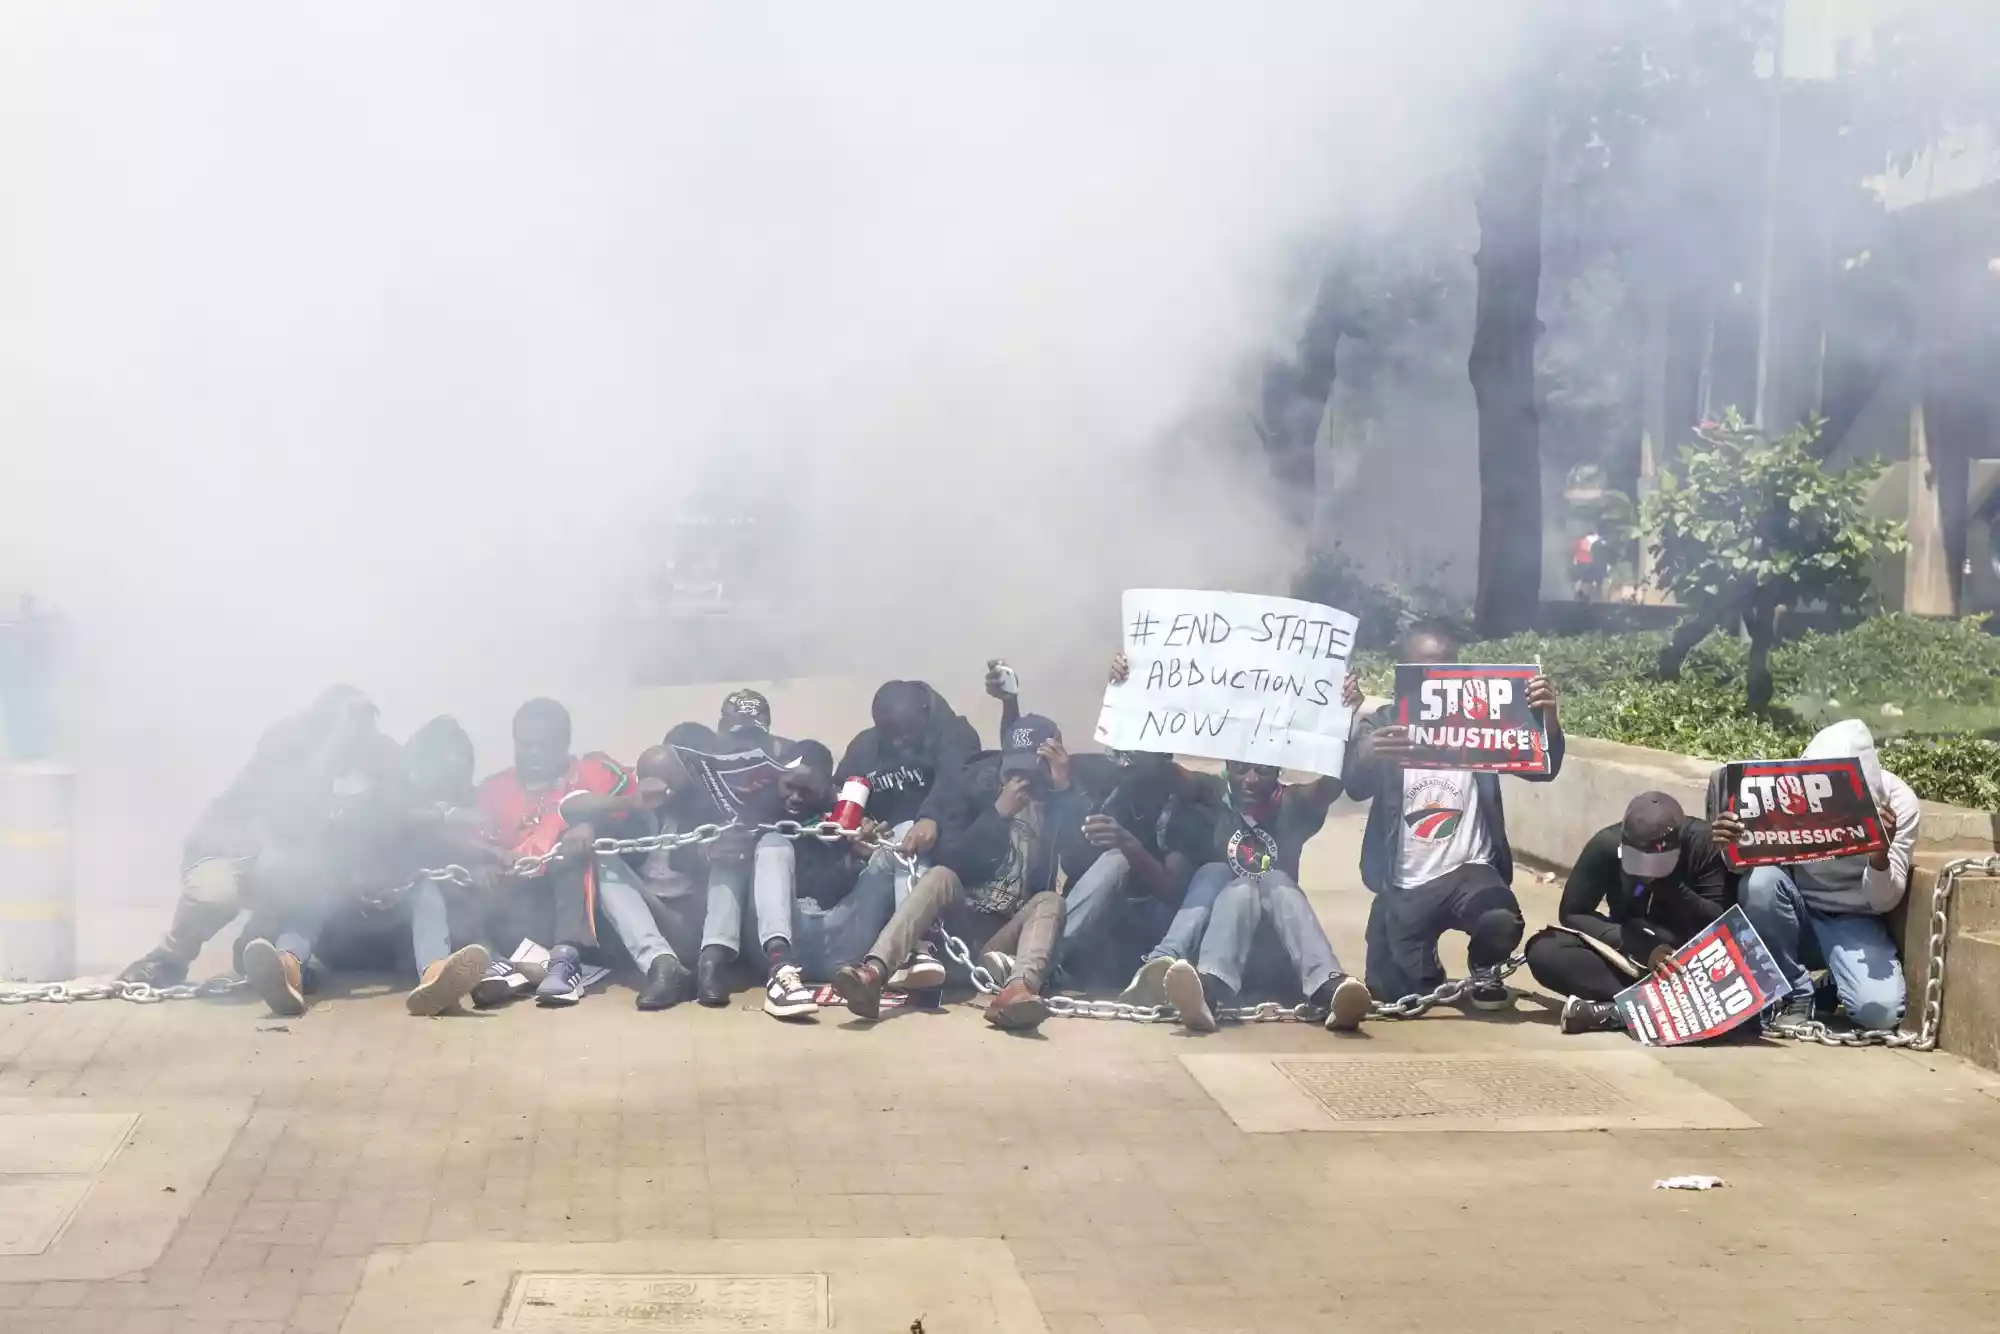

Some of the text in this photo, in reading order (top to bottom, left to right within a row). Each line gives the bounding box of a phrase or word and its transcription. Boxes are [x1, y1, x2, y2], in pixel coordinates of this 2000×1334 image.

[1250, 612, 1351, 660] STATE
[1146, 657, 1332, 706] ABDUCTIONS
[1420, 678, 1513, 720] STOP
[1139, 708, 1230, 741] NOW
[1407, 723, 1530, 751] INJUSTICE
[1739, 773, 1834, 819] STOP
[1738, 825, 1865, 847] OPPRESSION
[1687, 954, 1727, 1025] VIOLENCE
[1719, 975, 1753, 1016] TO
